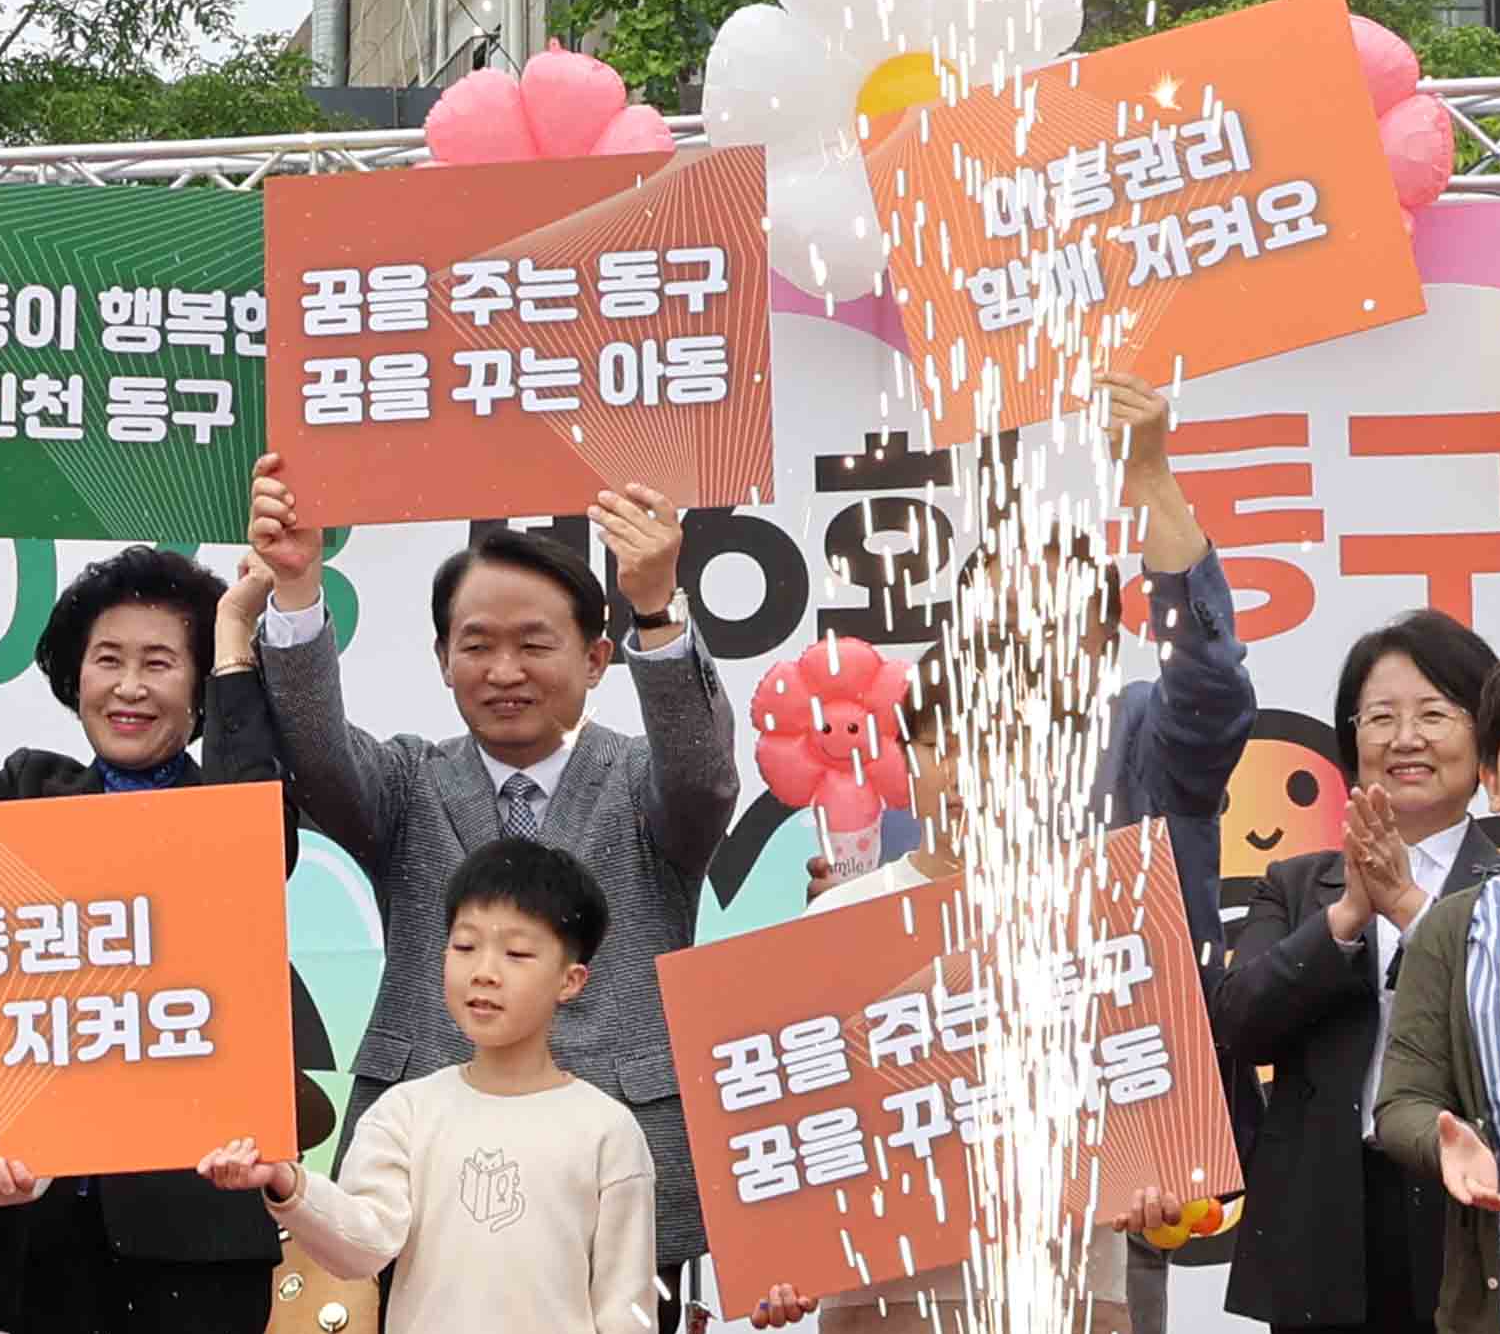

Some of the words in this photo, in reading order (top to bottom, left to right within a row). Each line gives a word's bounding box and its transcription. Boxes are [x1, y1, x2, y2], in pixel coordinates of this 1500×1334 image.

[1117, 179, 1328, 287] 지켜요
[301, 264, 430, 336] 꿈을
[450, 258, 580, 326] 주는
[598, 246, 728, 319] 동구
[105, 376, 235, 444] 동구
[302, 352, 431, 425] 꿈을
[451, 347, 582, 416] 꾸는
[600, 335, 729, 407] 아동
[1, 987, 215, 1068] 지켜요
[712, 1014, 852, 1113] 꿈을
[864, 984, 1000, 1068] 주는
[729, 1107, 869, 1204] 꿈을
